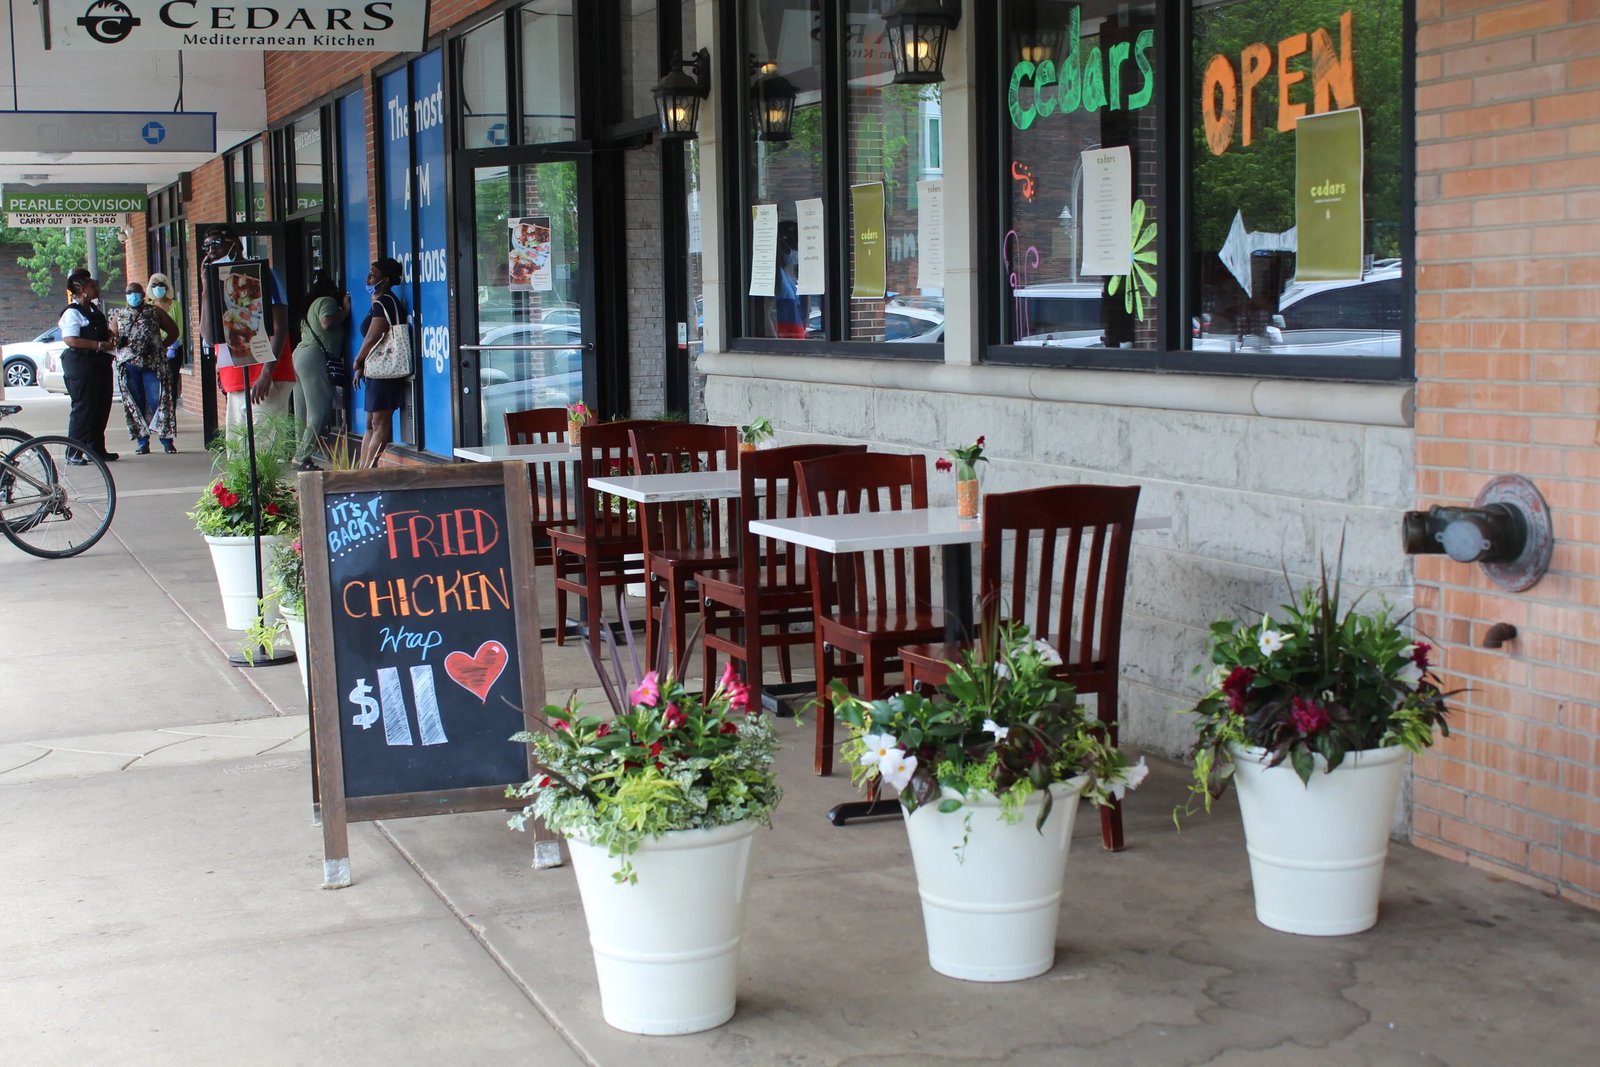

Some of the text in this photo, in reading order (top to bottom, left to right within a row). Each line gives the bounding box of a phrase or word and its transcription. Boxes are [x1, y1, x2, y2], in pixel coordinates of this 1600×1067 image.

[158, 0, 394, 31] CEDARS
[183, 32, 375, 47] Mediterranean Kitchen
[1008, 4, 1154, 130] cedars
[1202, 9, 1355, 156] OPEN
[388, 95, 408, 141] The
[10, 199, 141, 210] PEARLE VISION
[404, 162, 431, 211] AM
[1310, 178, 1346, 197] cedars
[861, 228, 878, 241] cedars
[392, 237, 447, 284] cions
[328, 497, 380, 553] BACK!
[385, 508, 499, 560] FRIED
[343, 567, 510, 618] CHICKEN
[379, 625, 442, 661] Wrap
[349, 664, 449, 746] $11
